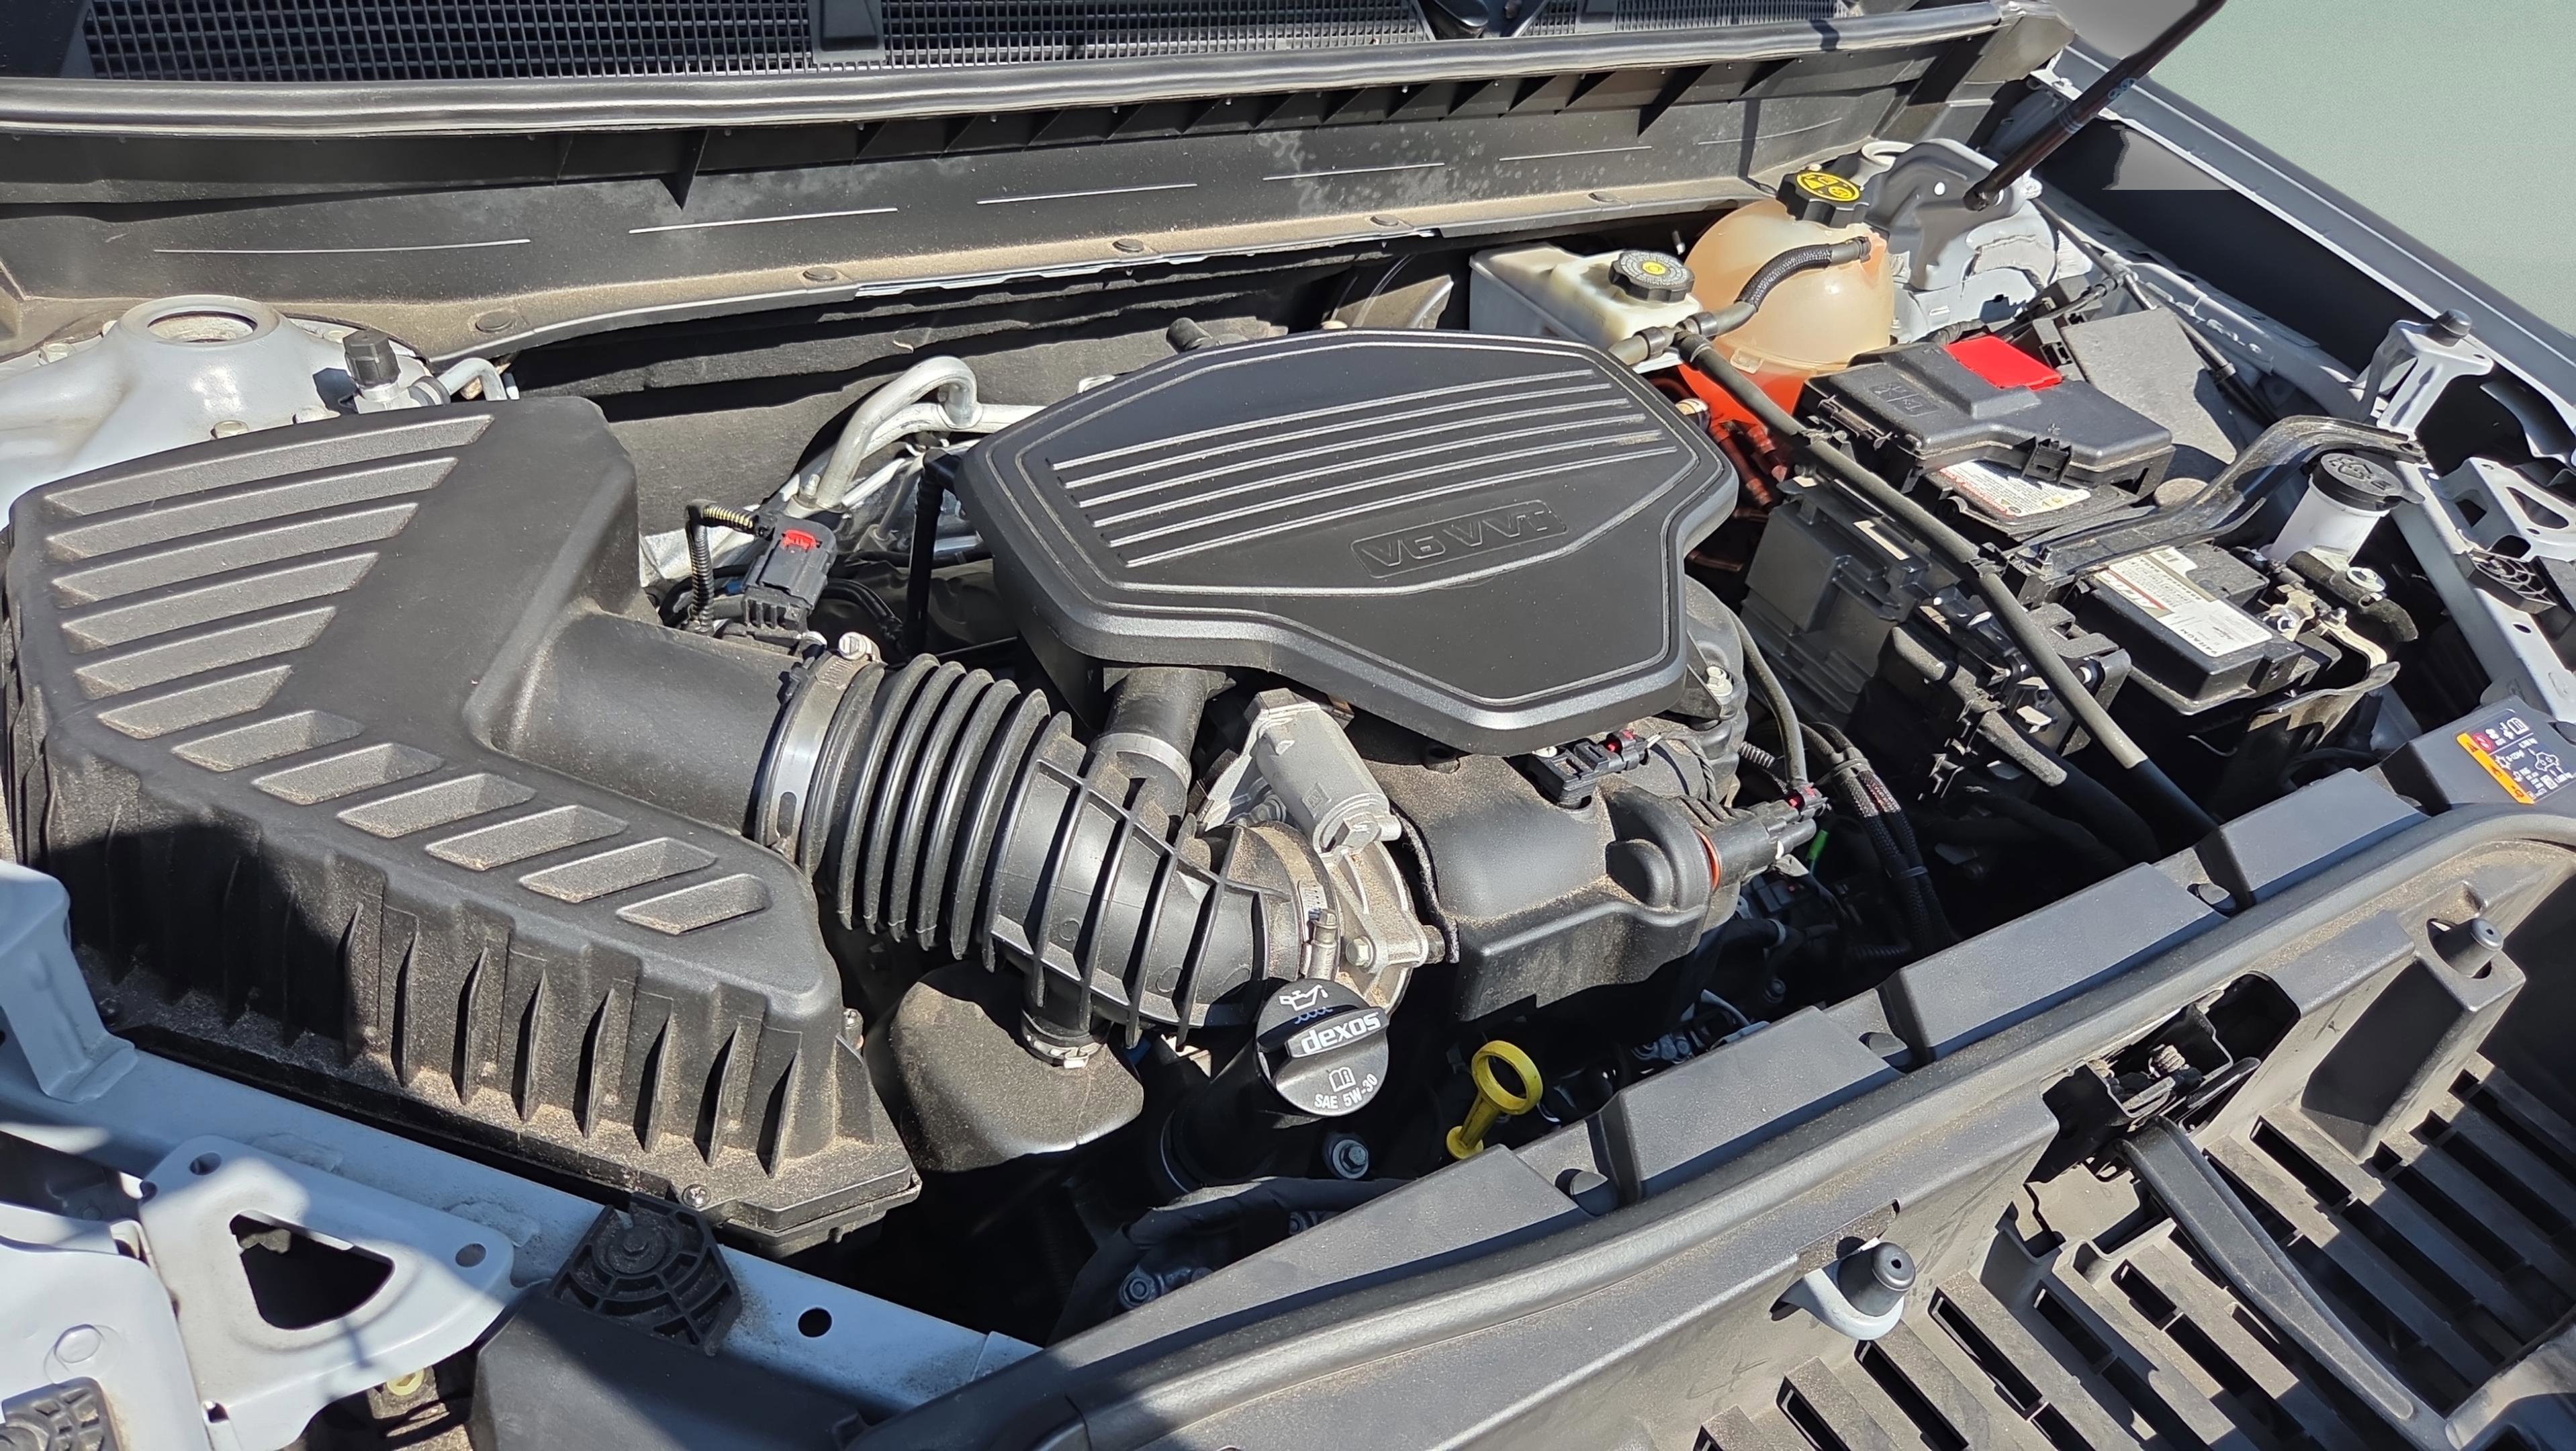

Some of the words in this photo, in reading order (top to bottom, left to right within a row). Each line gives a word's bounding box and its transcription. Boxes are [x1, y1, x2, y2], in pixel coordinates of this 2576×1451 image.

[1361, 535, 1446, 567] V6
[1443, 510, 1549, 547] VVT
[1301, 1013, 1381, 1054] dexos
[1314, 1094, 1338, 1110] SAE
[1343, 1073, 1378, 1107] 5W-30
